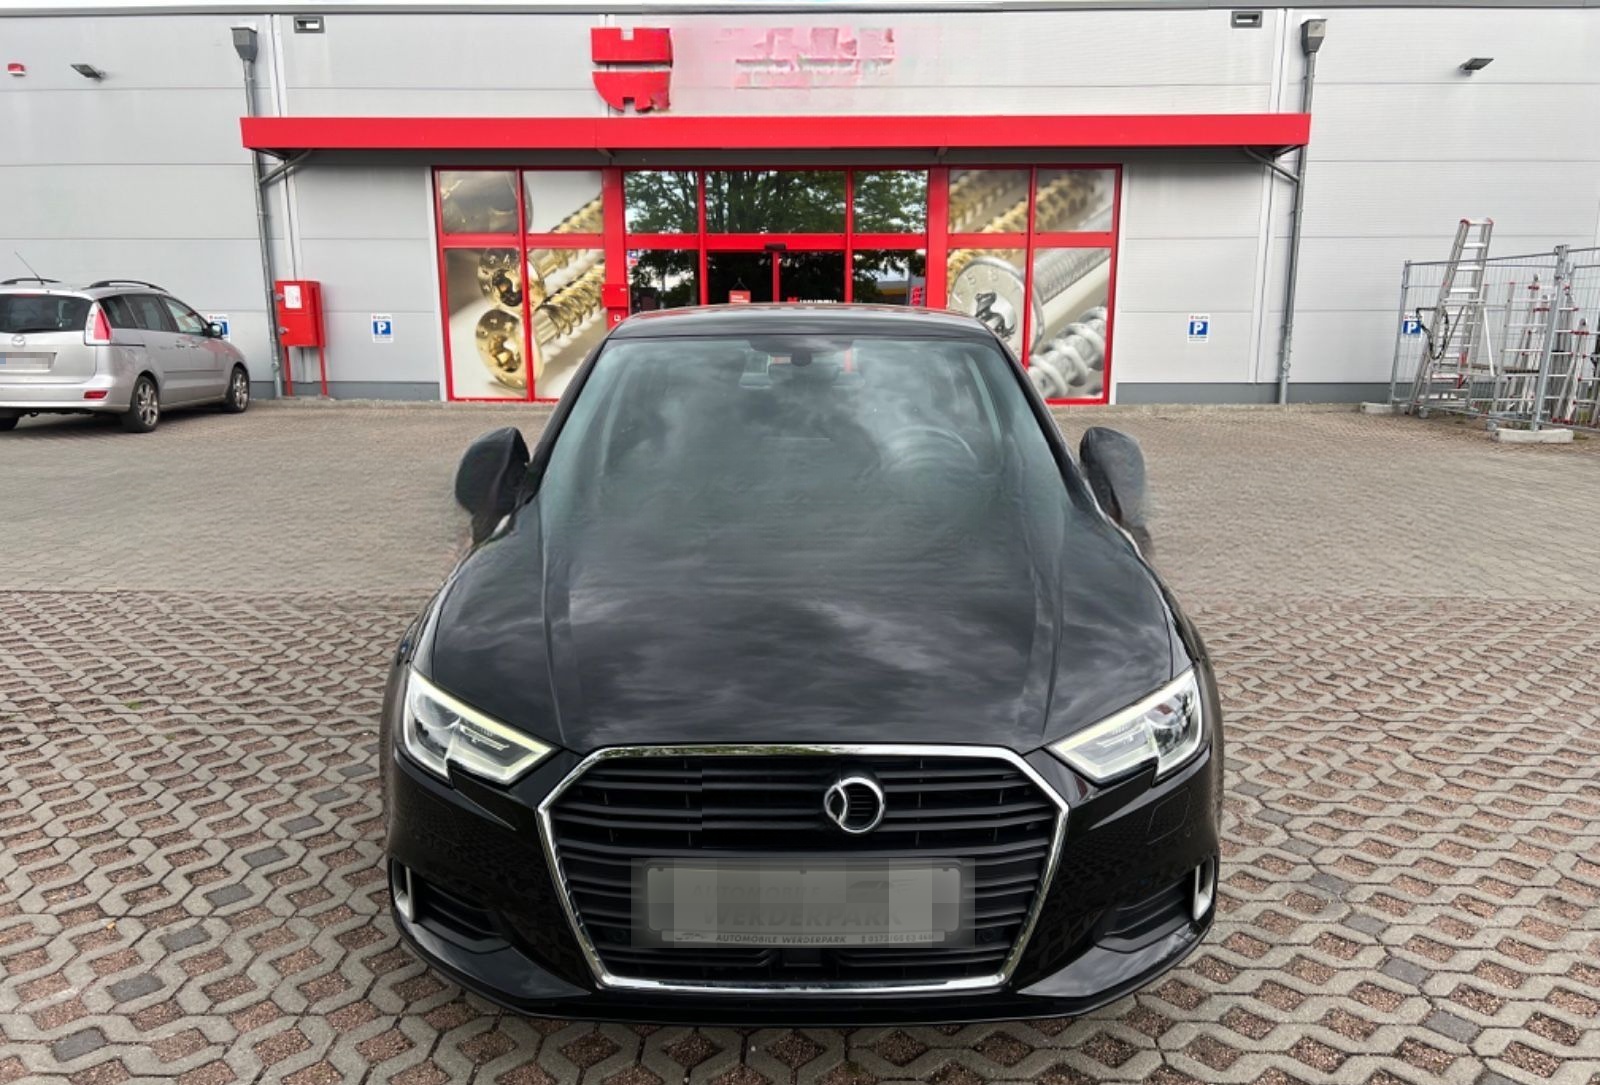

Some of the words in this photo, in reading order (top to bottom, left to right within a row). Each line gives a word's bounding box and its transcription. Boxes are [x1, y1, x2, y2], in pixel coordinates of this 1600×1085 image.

[377, 321, 387, 334] P
[1193, 321, 1204, 334] P
[1407, 321, 1417, 334] P
[703, 906, 903, 927] WERDERPARK
[715, 934, 778, 943] AUTOMOBILE
[782, 935, 847, 944] WERDERPARK
